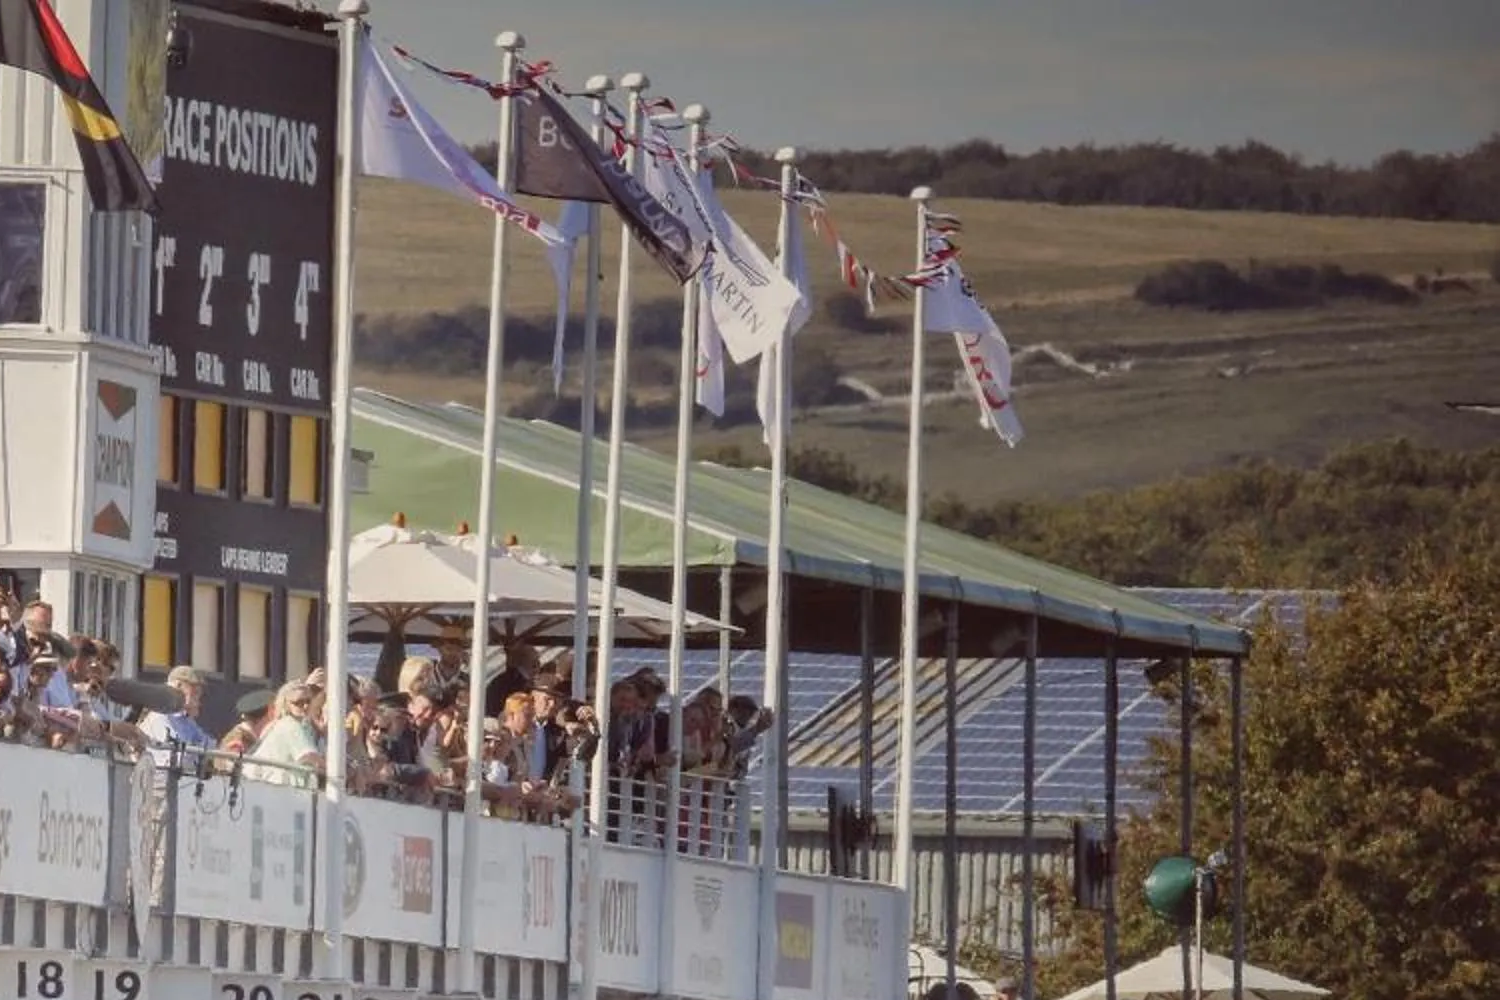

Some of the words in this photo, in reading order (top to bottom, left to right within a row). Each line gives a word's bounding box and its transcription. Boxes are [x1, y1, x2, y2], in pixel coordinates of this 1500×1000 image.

[214, 104, 319, 186] POSITIONS
[37, 790, 104, 872] Bonhams
[17, 960, 64, 999] 18
